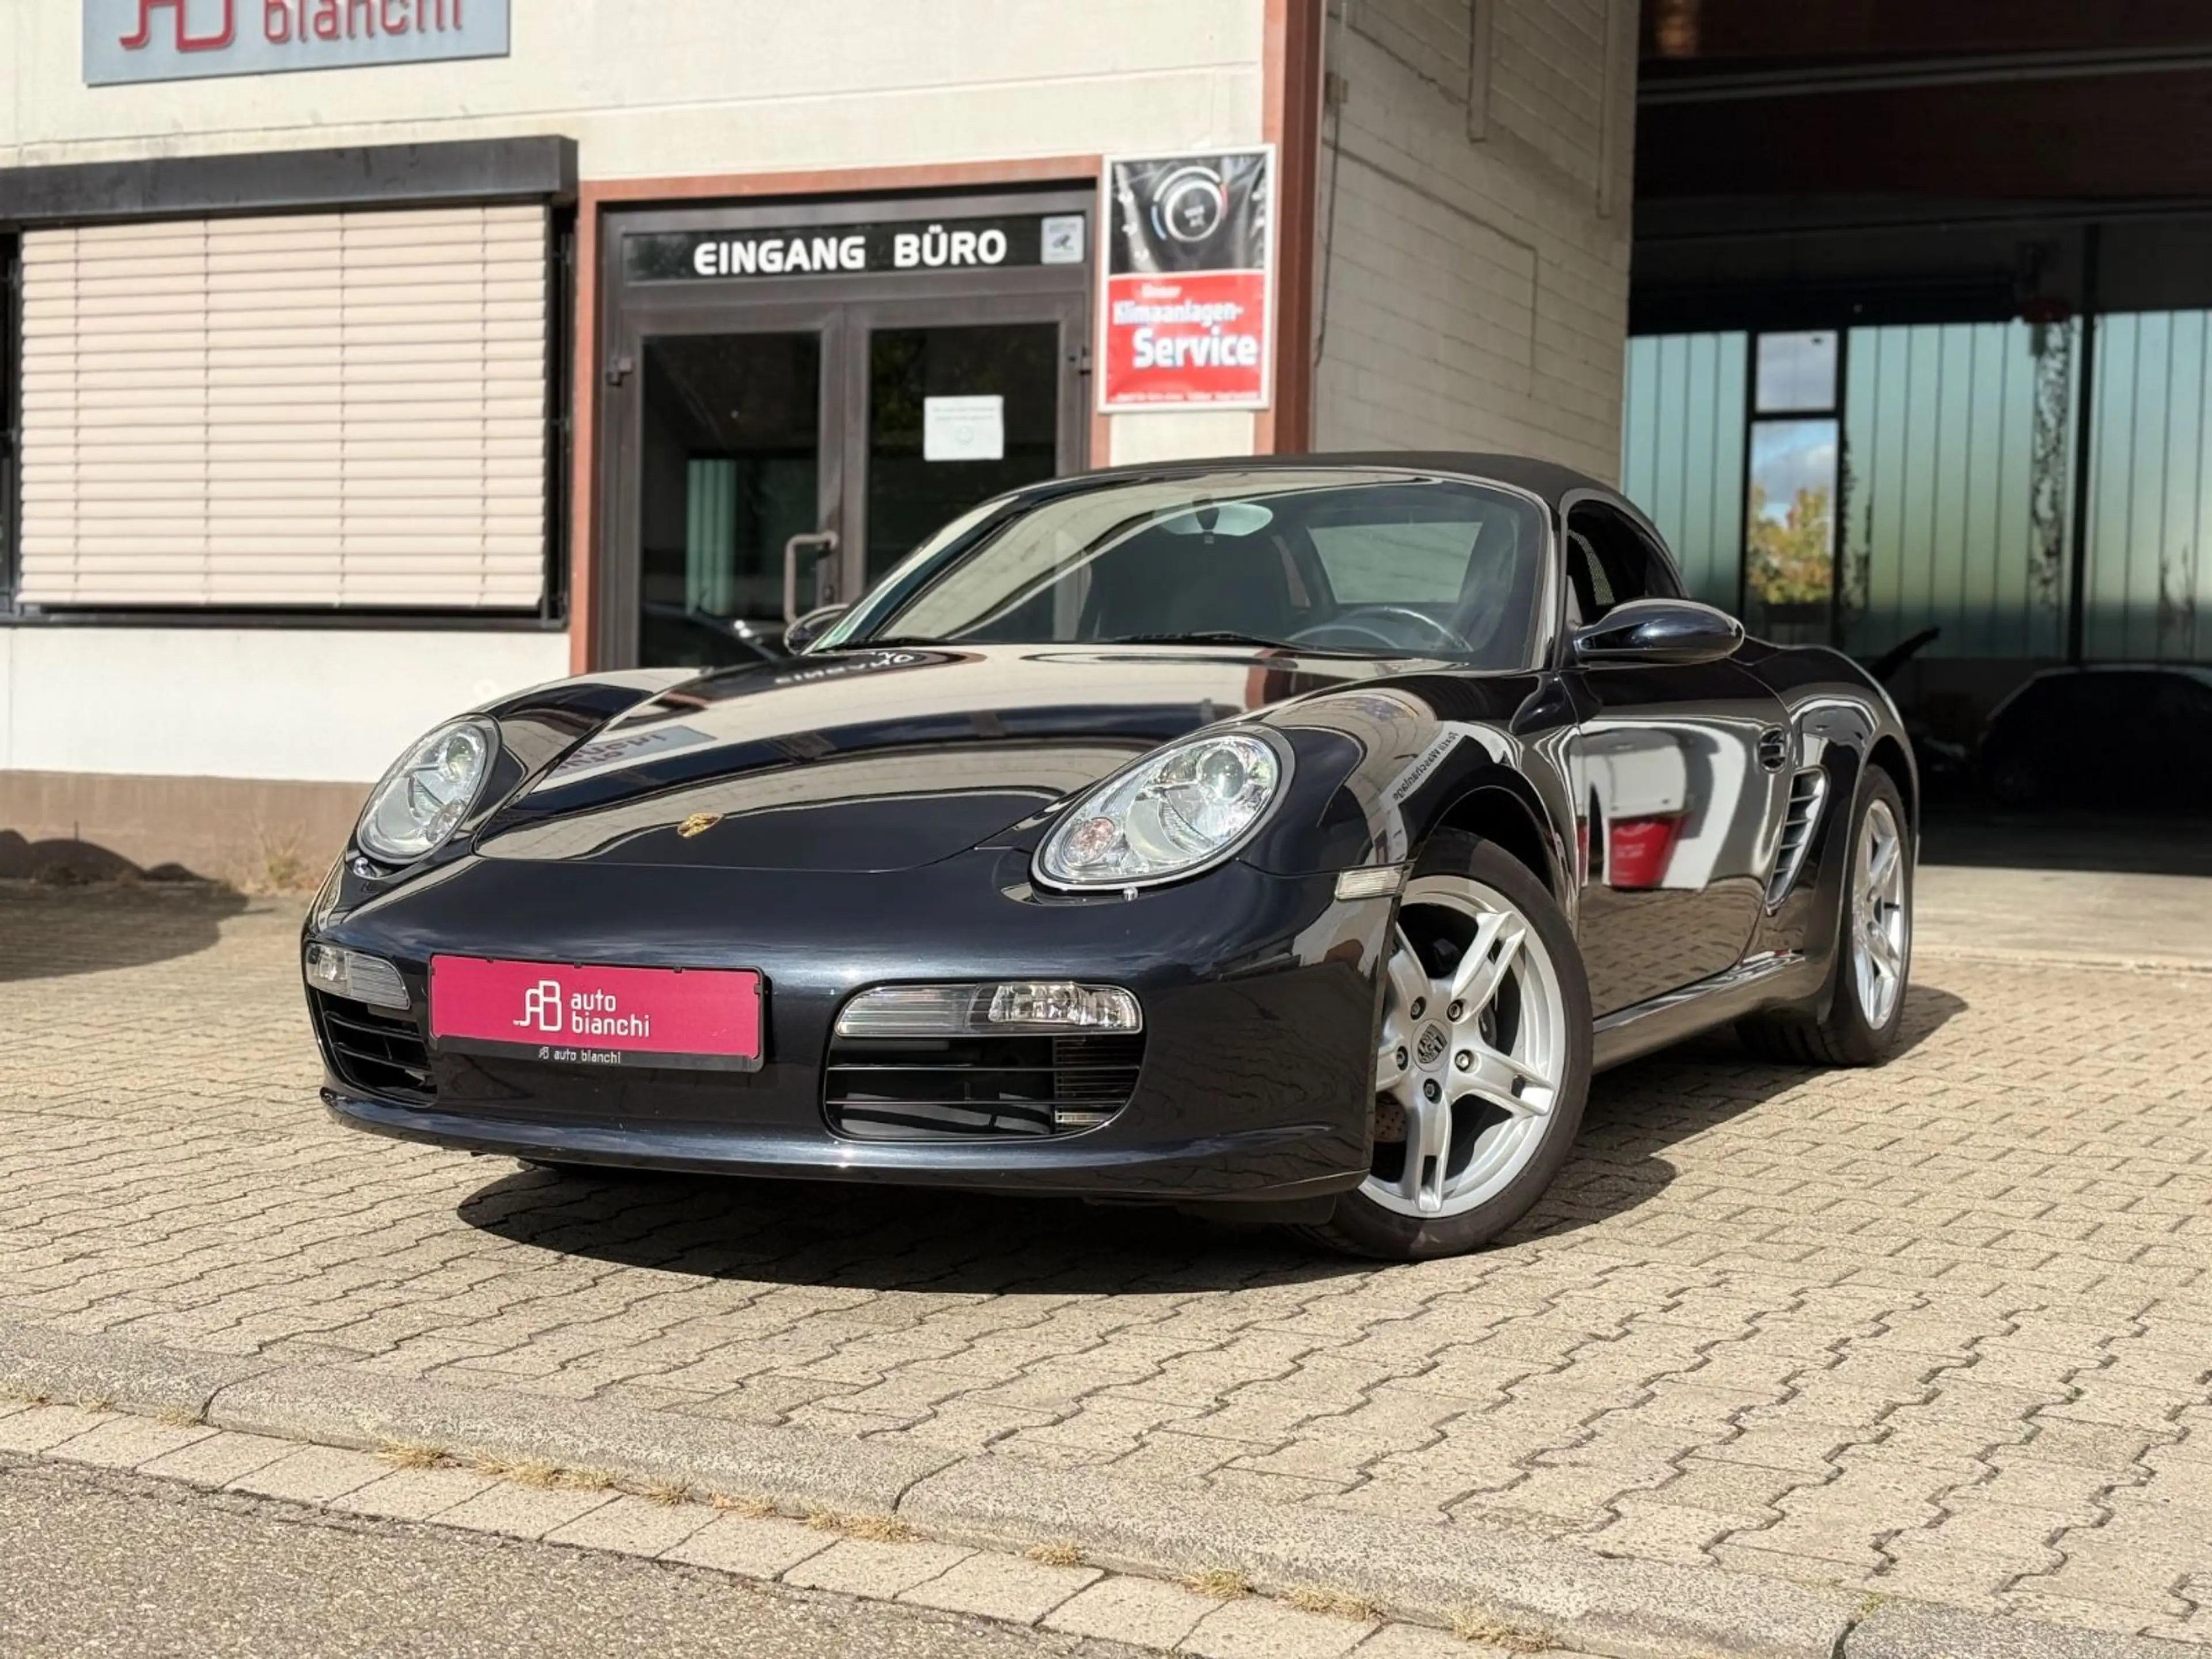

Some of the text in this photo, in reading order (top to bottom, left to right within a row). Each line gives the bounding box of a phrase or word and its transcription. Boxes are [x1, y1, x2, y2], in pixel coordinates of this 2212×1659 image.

[694, 236, 866, 275] EINGANG
[894, 224, 1007, 268] BÜRO
[1132, 325, 1258, 369] Service
[571, 988, 616, 1012] auto
[572, 1011, 649, 1037] bianchi
[554, 1048, 577, 1061] auto
[581, 1050, 621, 1064] bianchi
